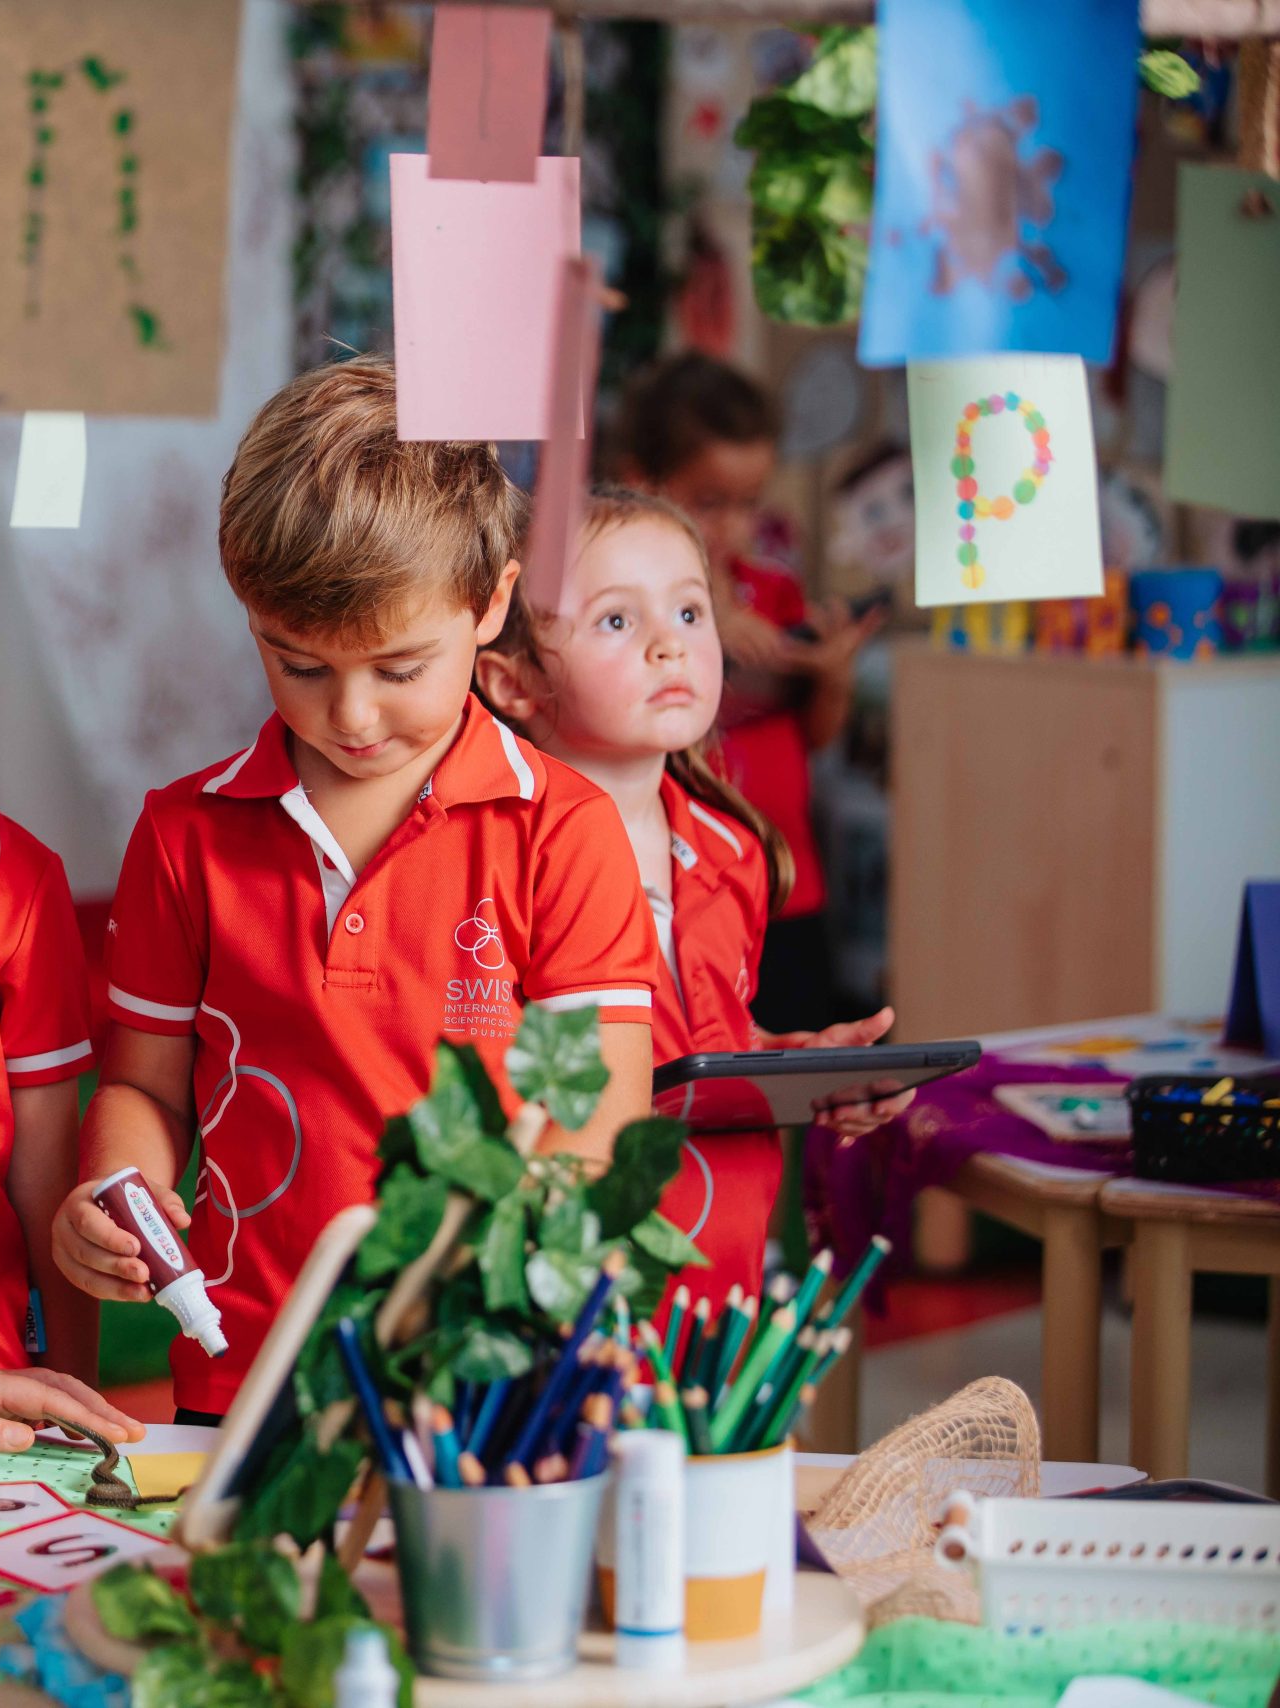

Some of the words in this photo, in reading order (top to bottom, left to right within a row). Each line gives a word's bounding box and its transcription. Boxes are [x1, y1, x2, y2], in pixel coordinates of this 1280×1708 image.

[445, 978, 512, 1003] SWIS
[444, 1016, 497, 1026] SCIENTIFIC
[470, 1027, 507, 1039] DUBAI
[129, 1190, 162, 1236] MARKERS
[158, 1234, 179, 1263] DOTS
